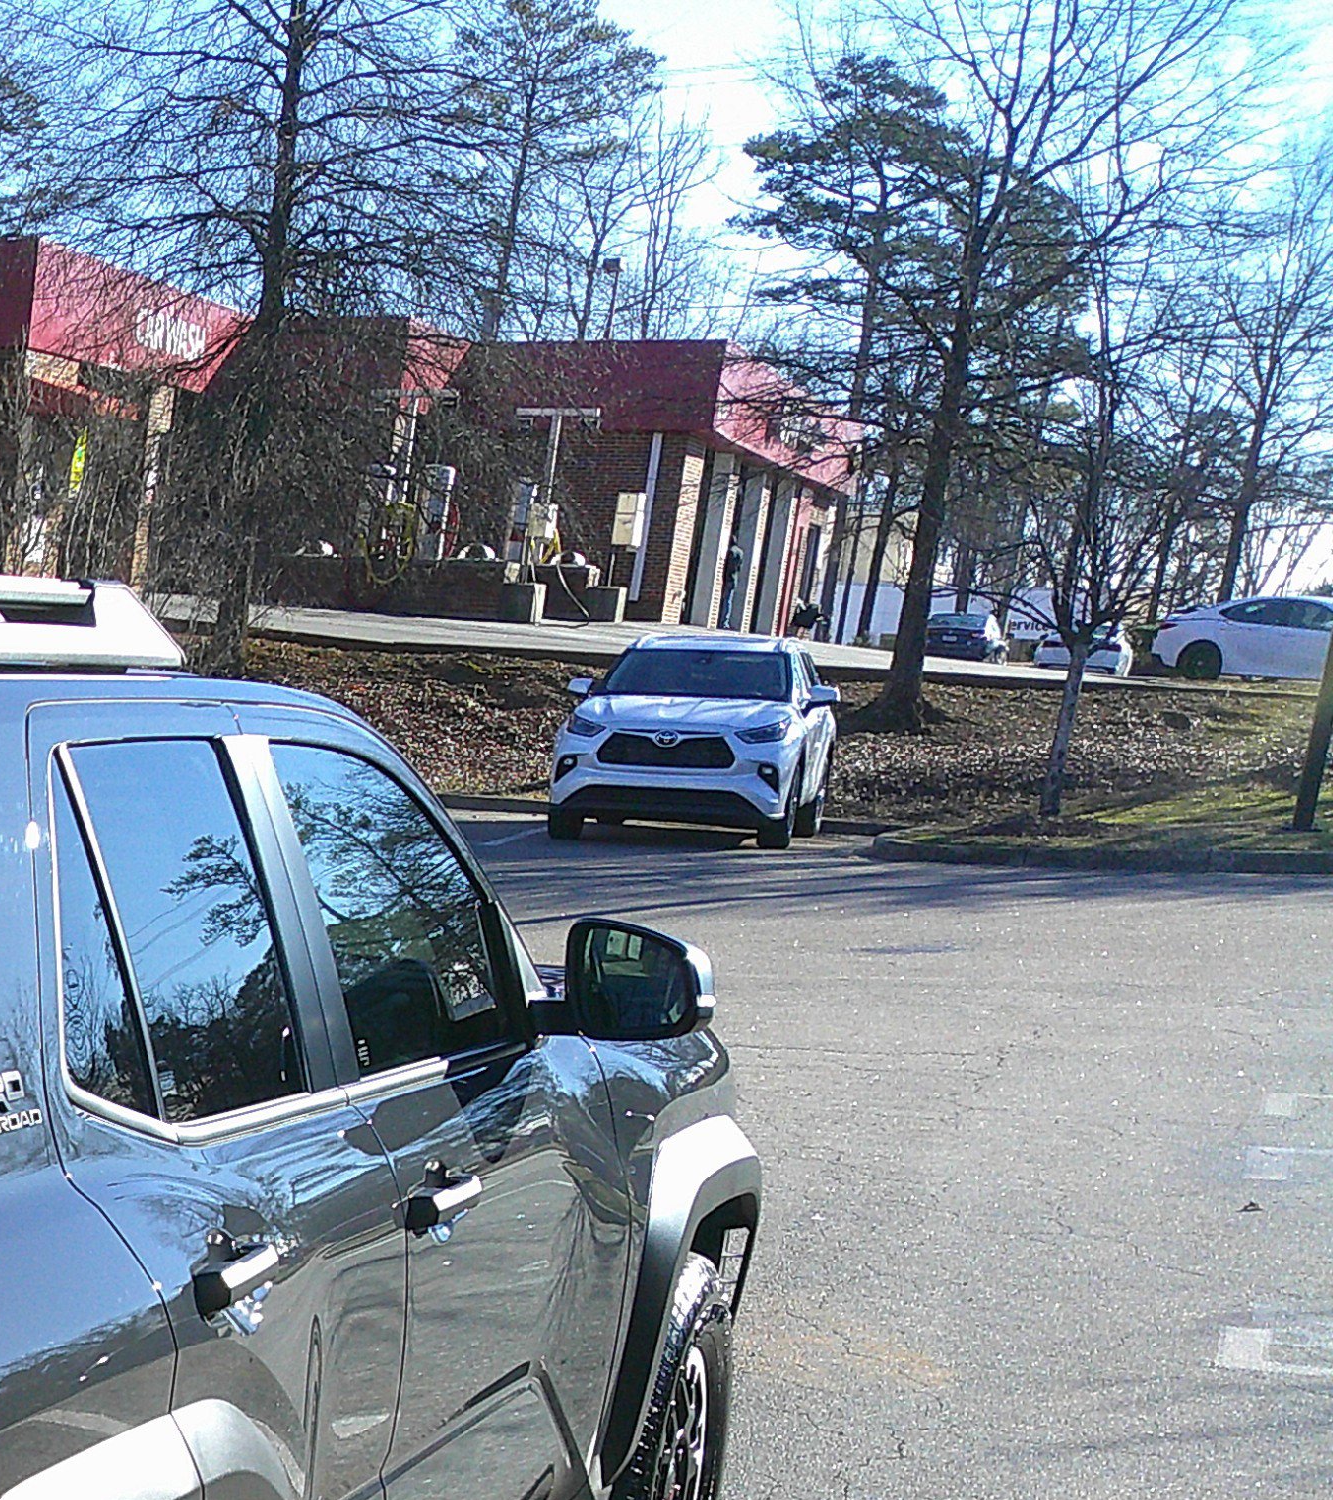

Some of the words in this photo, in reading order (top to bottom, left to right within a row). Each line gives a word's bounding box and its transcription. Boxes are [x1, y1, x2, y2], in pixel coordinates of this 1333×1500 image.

[136, 308, 165, 350] CAR
[165, 313, 206, 361] WASH
[1009, 619, 1049, 632] ervice
